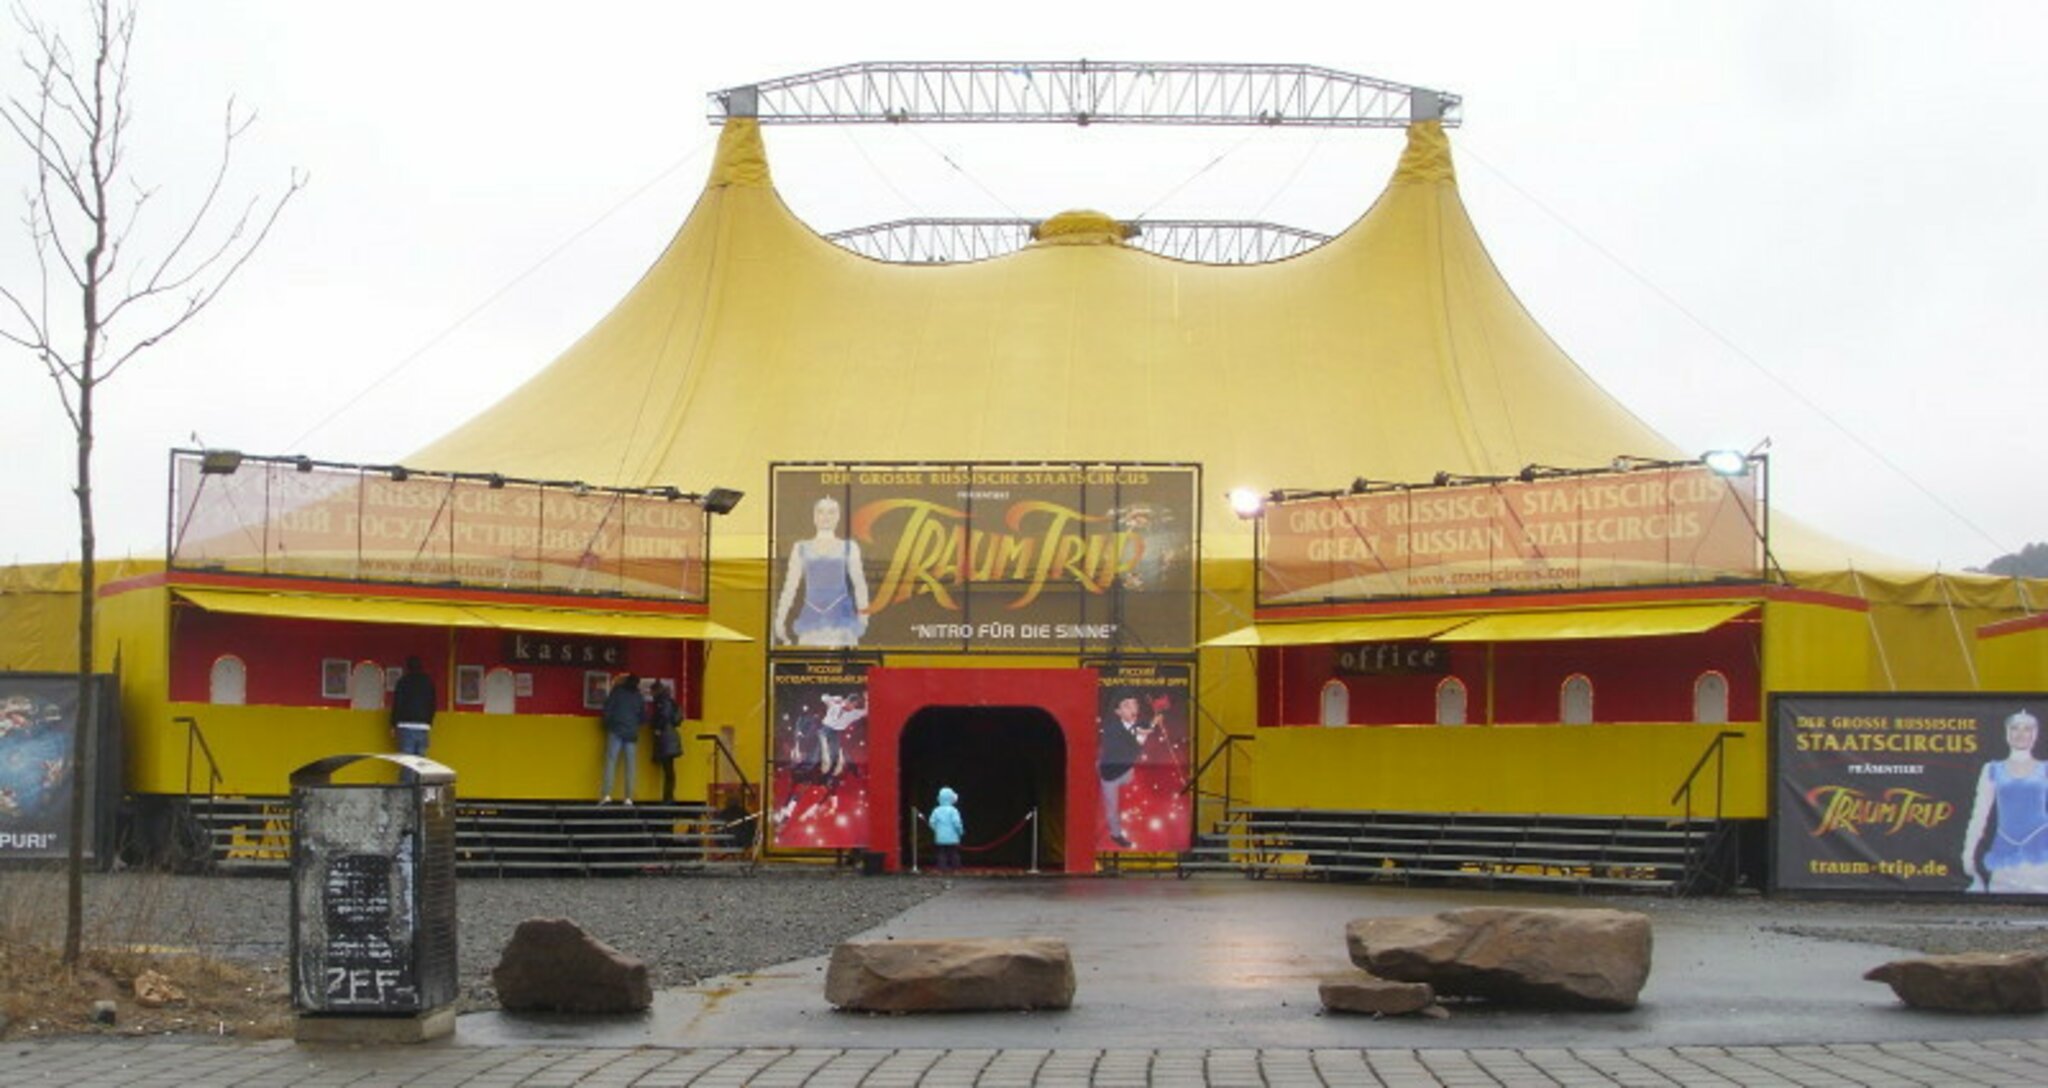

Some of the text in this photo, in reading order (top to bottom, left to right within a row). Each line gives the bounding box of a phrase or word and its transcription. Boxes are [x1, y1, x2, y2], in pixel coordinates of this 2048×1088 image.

[821, 472, 1149, 485] DER GROSSE RUSSISCHE STAATSCIRCUS
[1289, 506, 1370, 533] GROOT
[1522, 477, 1724, 516] STAATSCIRCUS
[1396, 526, 1504, 556] RUSSIAN
[1522, 511, 1700, 547] STATECIRCUS
[978, 622, 1015, 639] FÜR
[1021, 624, 1050, 639] DIE
[515, 635, 617, 663] kasse
[1341, 644, 1436, 670] office
[1797, 716, 1977, 731] DER GROSSE RUSSISCHE
[1796, 734, 1977, 752] STAATSCIRCUS
[1810, 859, 1948, 878] traum-trip.de
